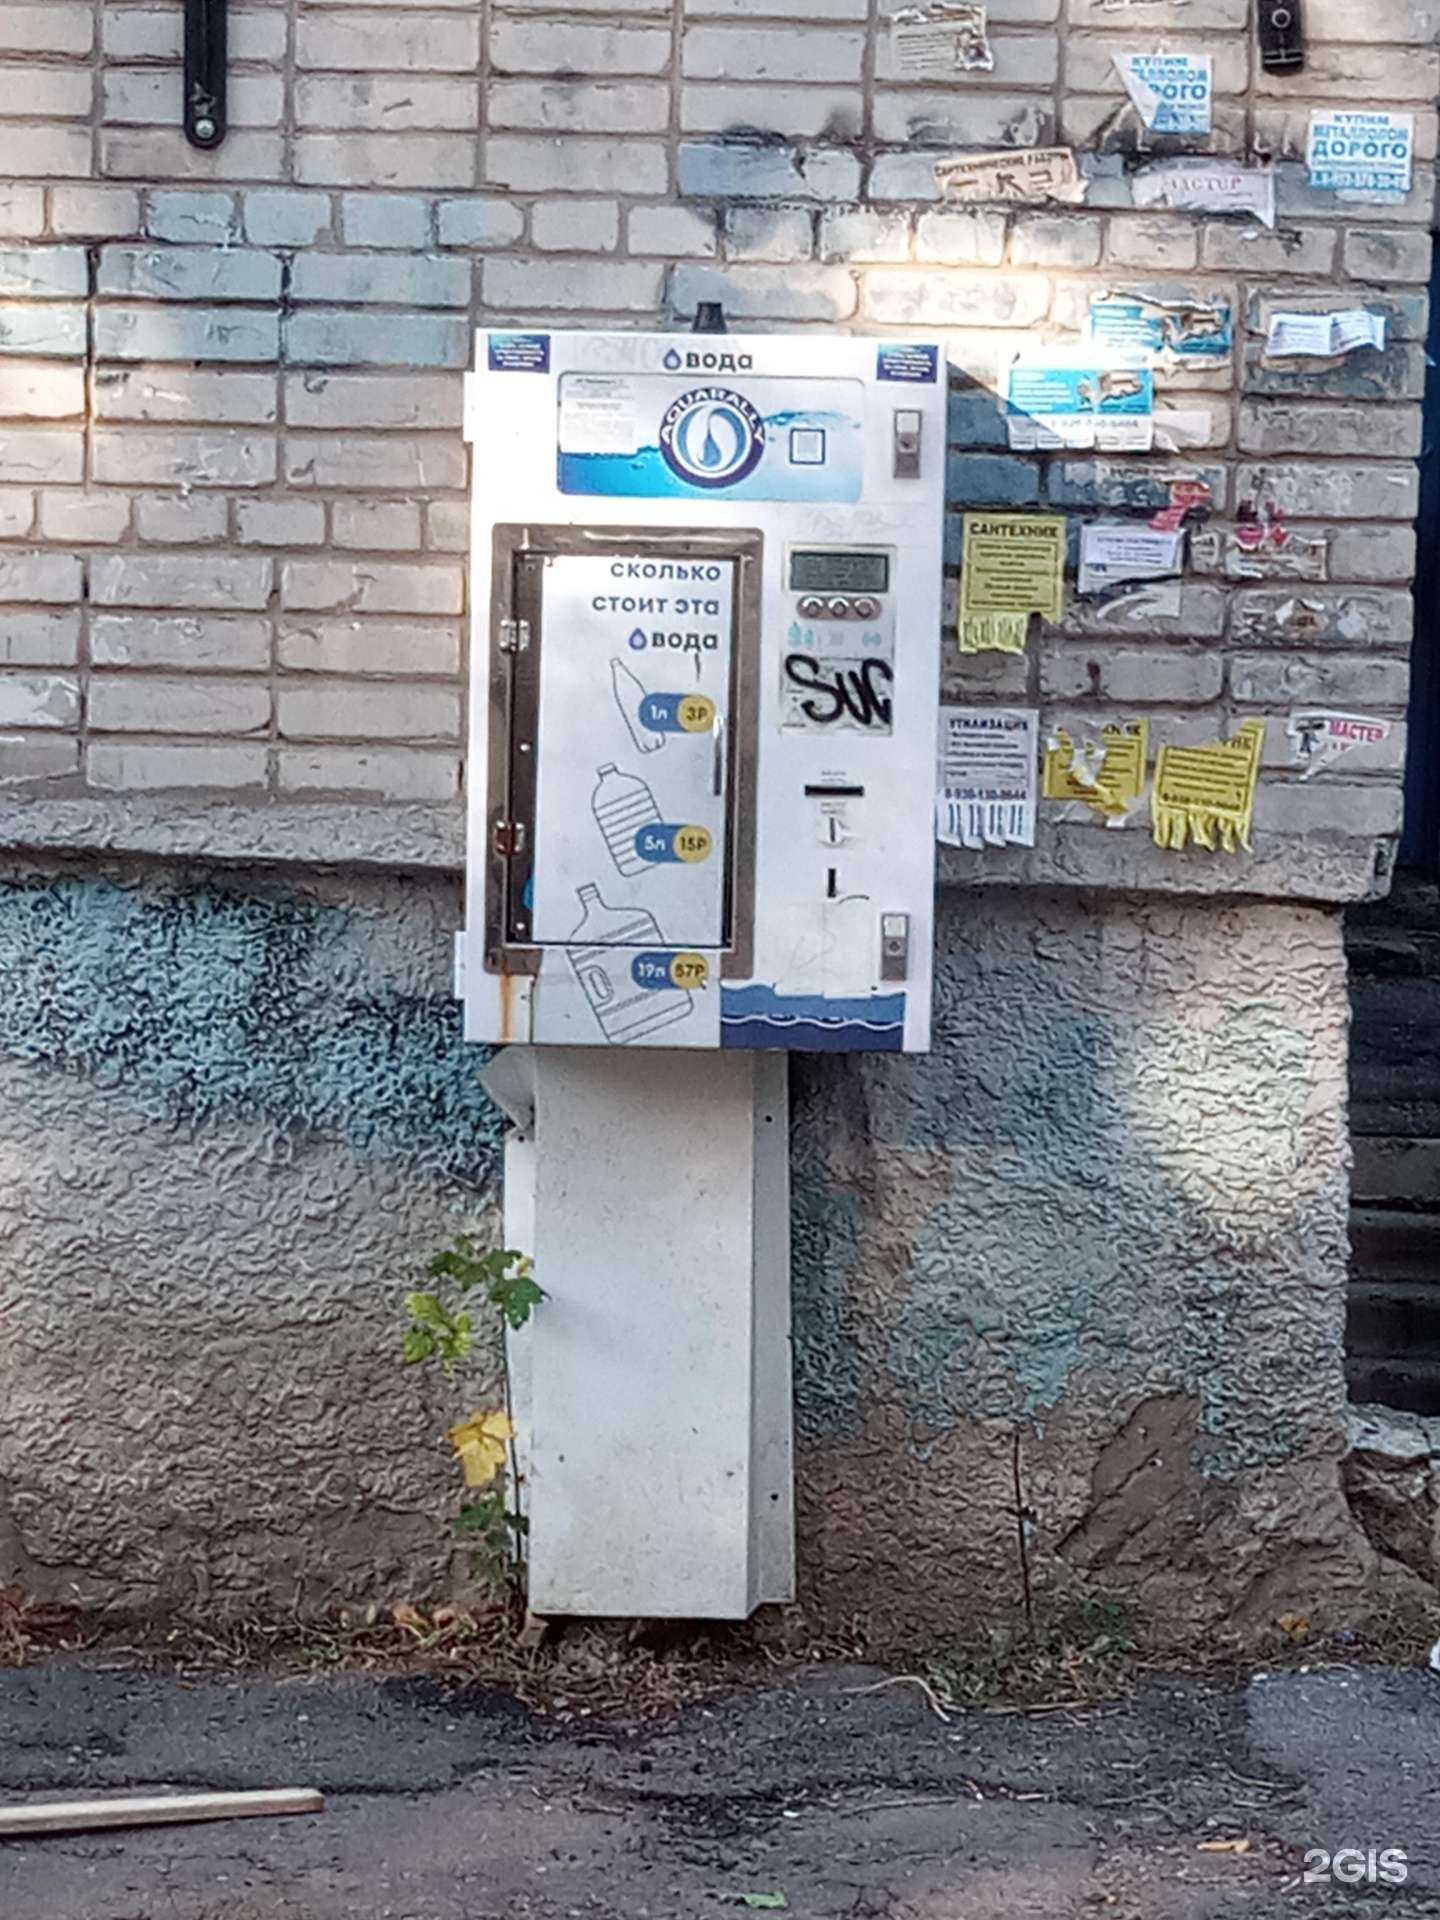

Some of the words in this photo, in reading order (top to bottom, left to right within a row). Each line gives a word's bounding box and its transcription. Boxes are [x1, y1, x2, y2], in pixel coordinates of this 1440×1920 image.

[1148, 84, 1207, 100] РОГО
[1312, 141, 1408, 159] ДОРОГО
[970, 522, 1058, 538] САНТЕХНИК
